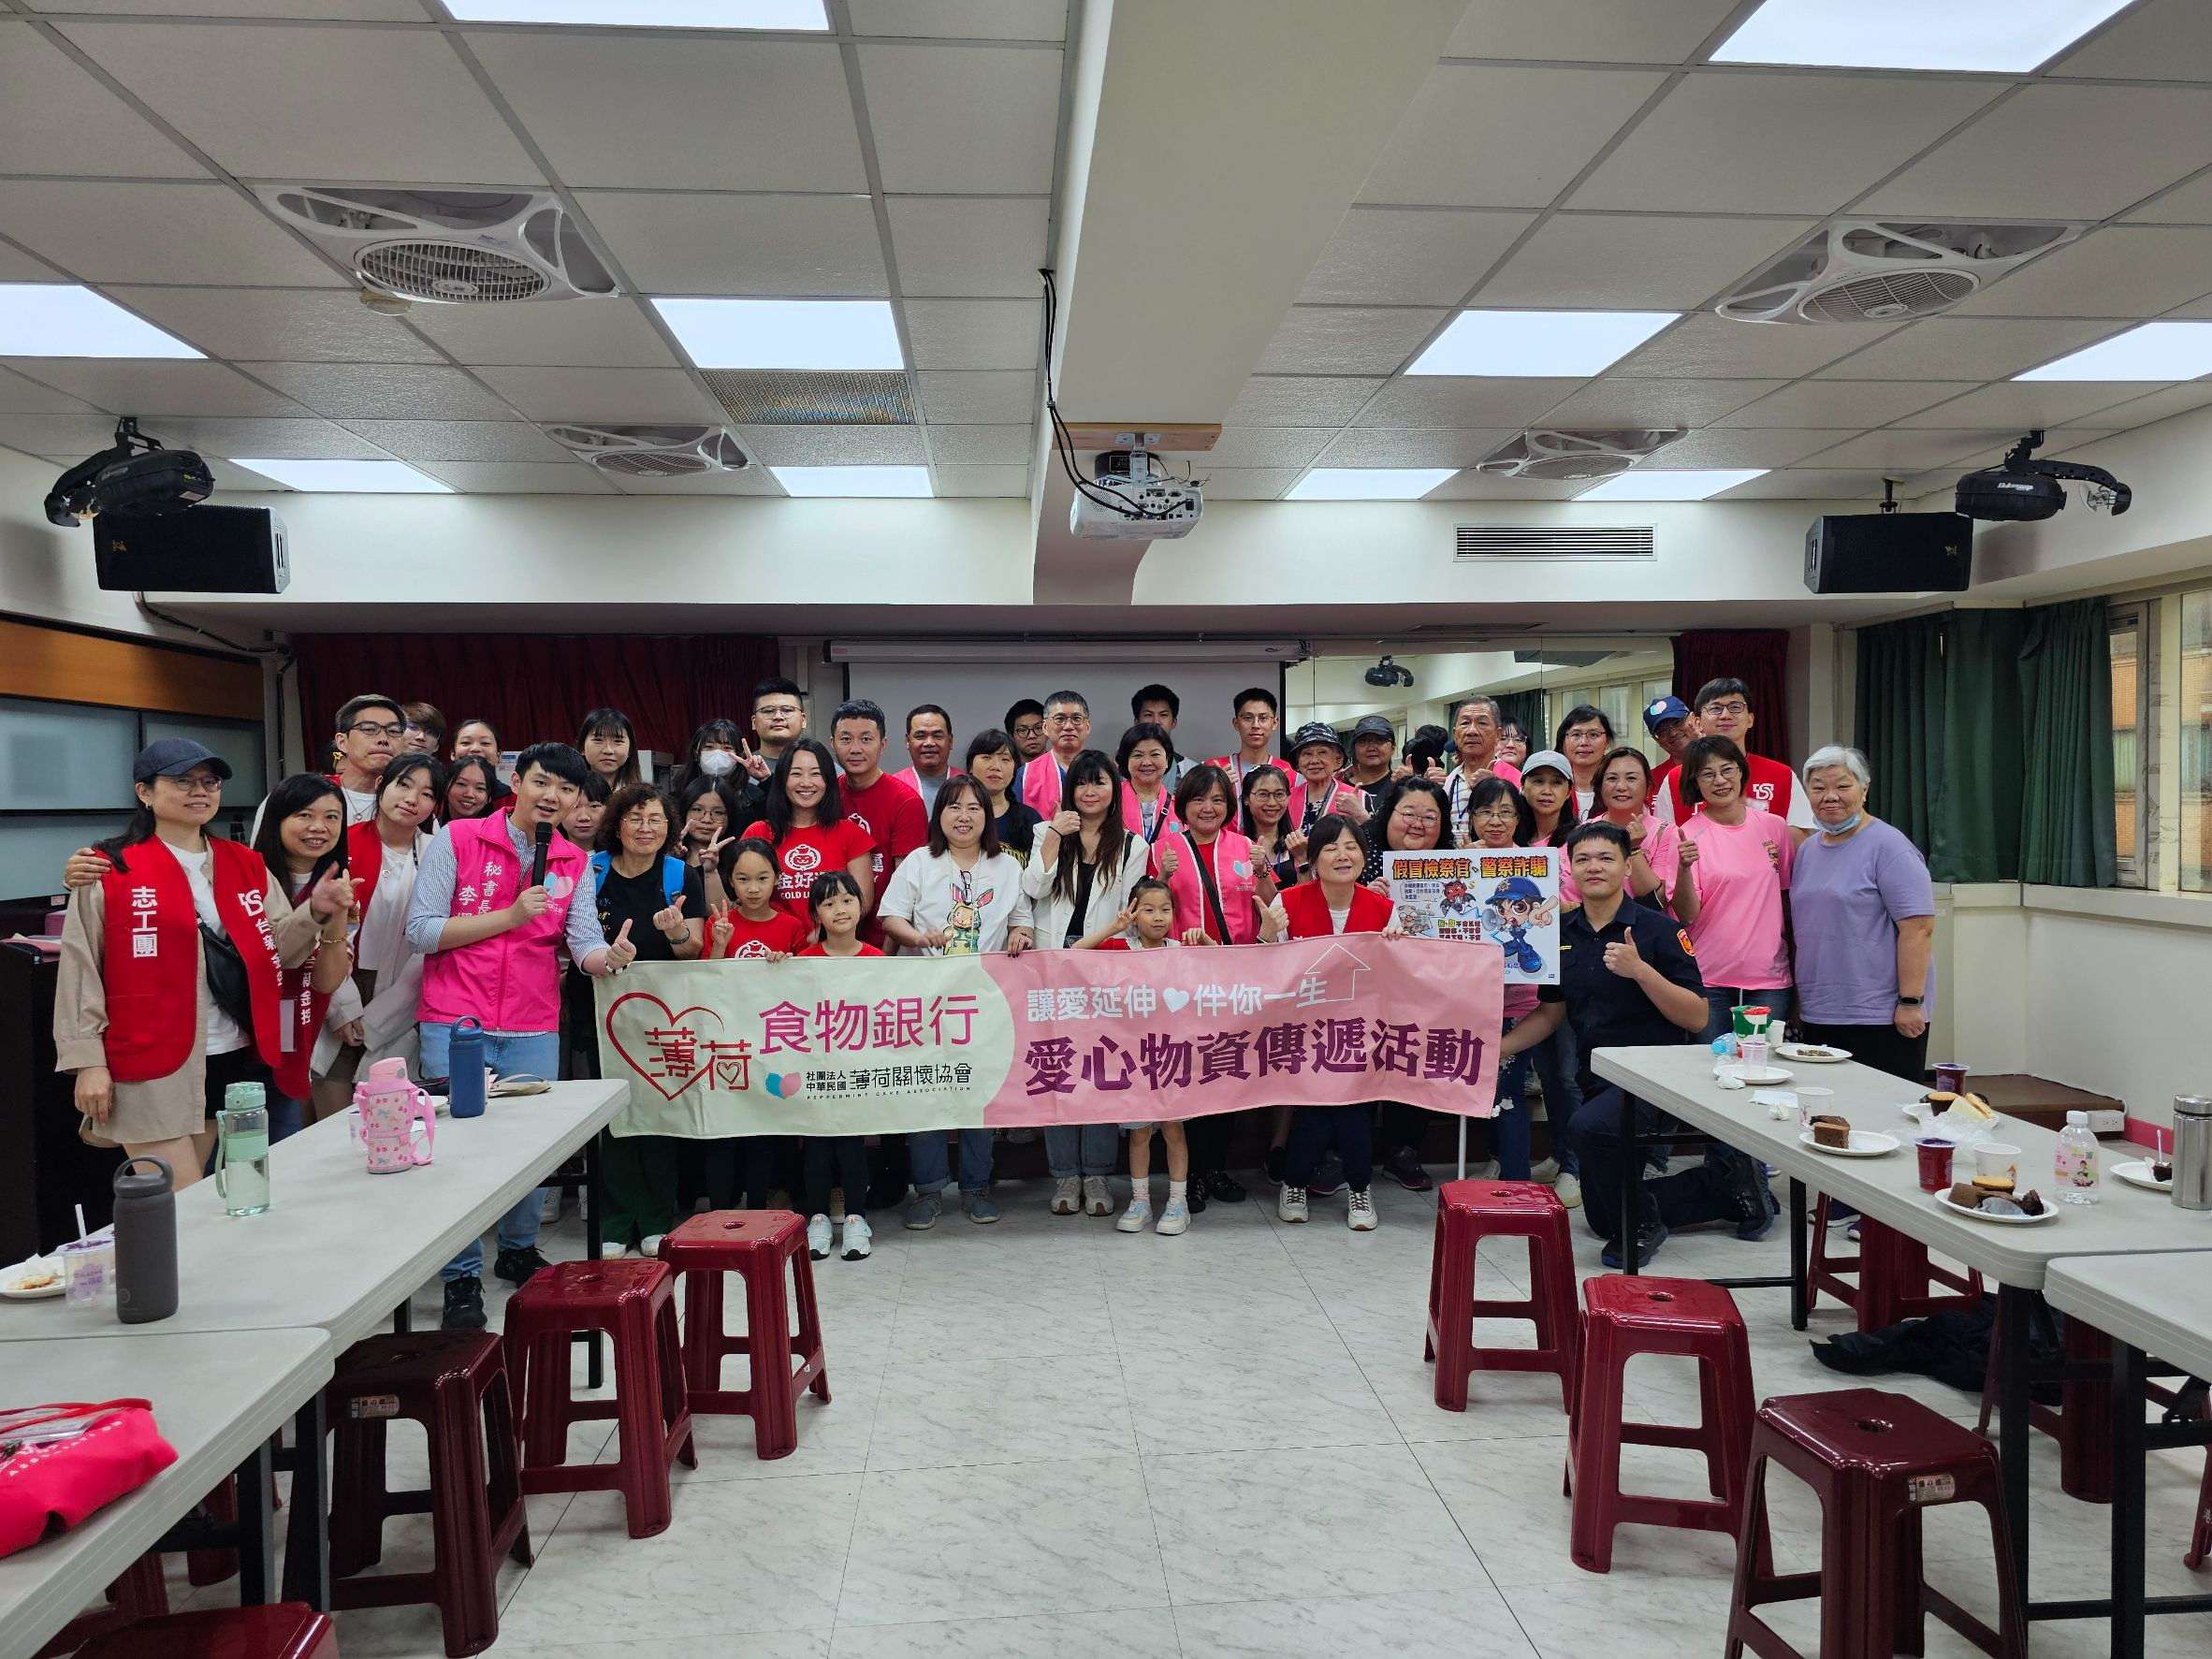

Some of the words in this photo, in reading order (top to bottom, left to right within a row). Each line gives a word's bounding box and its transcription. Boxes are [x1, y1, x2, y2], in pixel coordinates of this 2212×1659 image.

[776, 871, 825, 890] 金好
[1392, 855, 1549, 880] 假冒檢察官、警察詐騙
[458, 885, 478, 917] 李
[478, 861, 502, 914] 秘書長
[131, 885, 158, 958] 志工團
[1026, 986, 1157, 1022] 讓愛延伸
[1193, 977, 1328, 1017] 伴你一生
[758, 996, 980, 1055] 食物銀行
[645, 1026, 752, 1091] 薄荷
[1024, 1017, 1486, 1096] 愛心物資傳遞活動
[806, 1070, 847, 1082] 社團法人
[806, 1081, 847, 1092] 中華民國
[849, 1063, 973, 1090] 薄荷關懷協會
